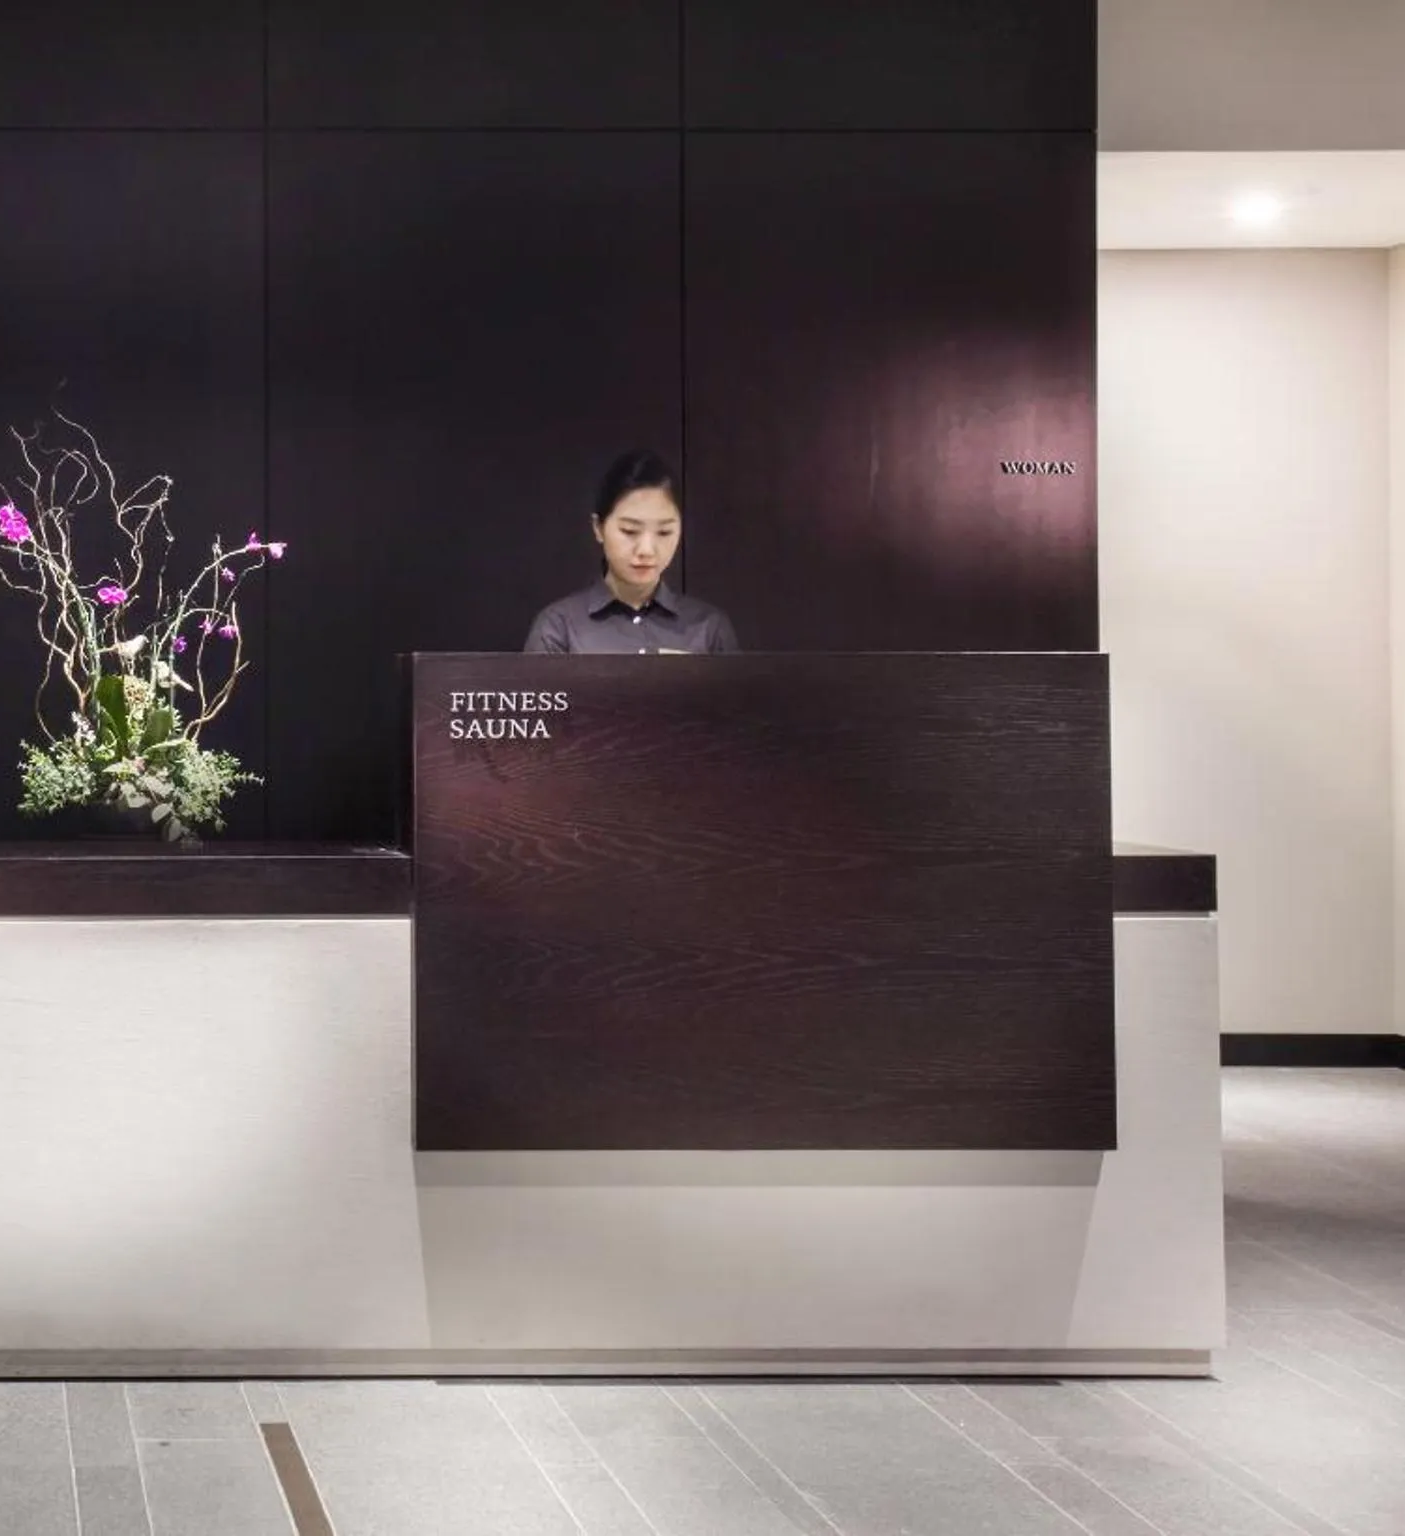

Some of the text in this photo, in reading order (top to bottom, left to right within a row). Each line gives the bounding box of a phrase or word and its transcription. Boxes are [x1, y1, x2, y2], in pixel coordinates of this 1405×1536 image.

[1000, 461, 1075, 475] WOMAN
[450, 692, 569, 712] FITNESS
[450, 719, 551, 739] SAUNA
